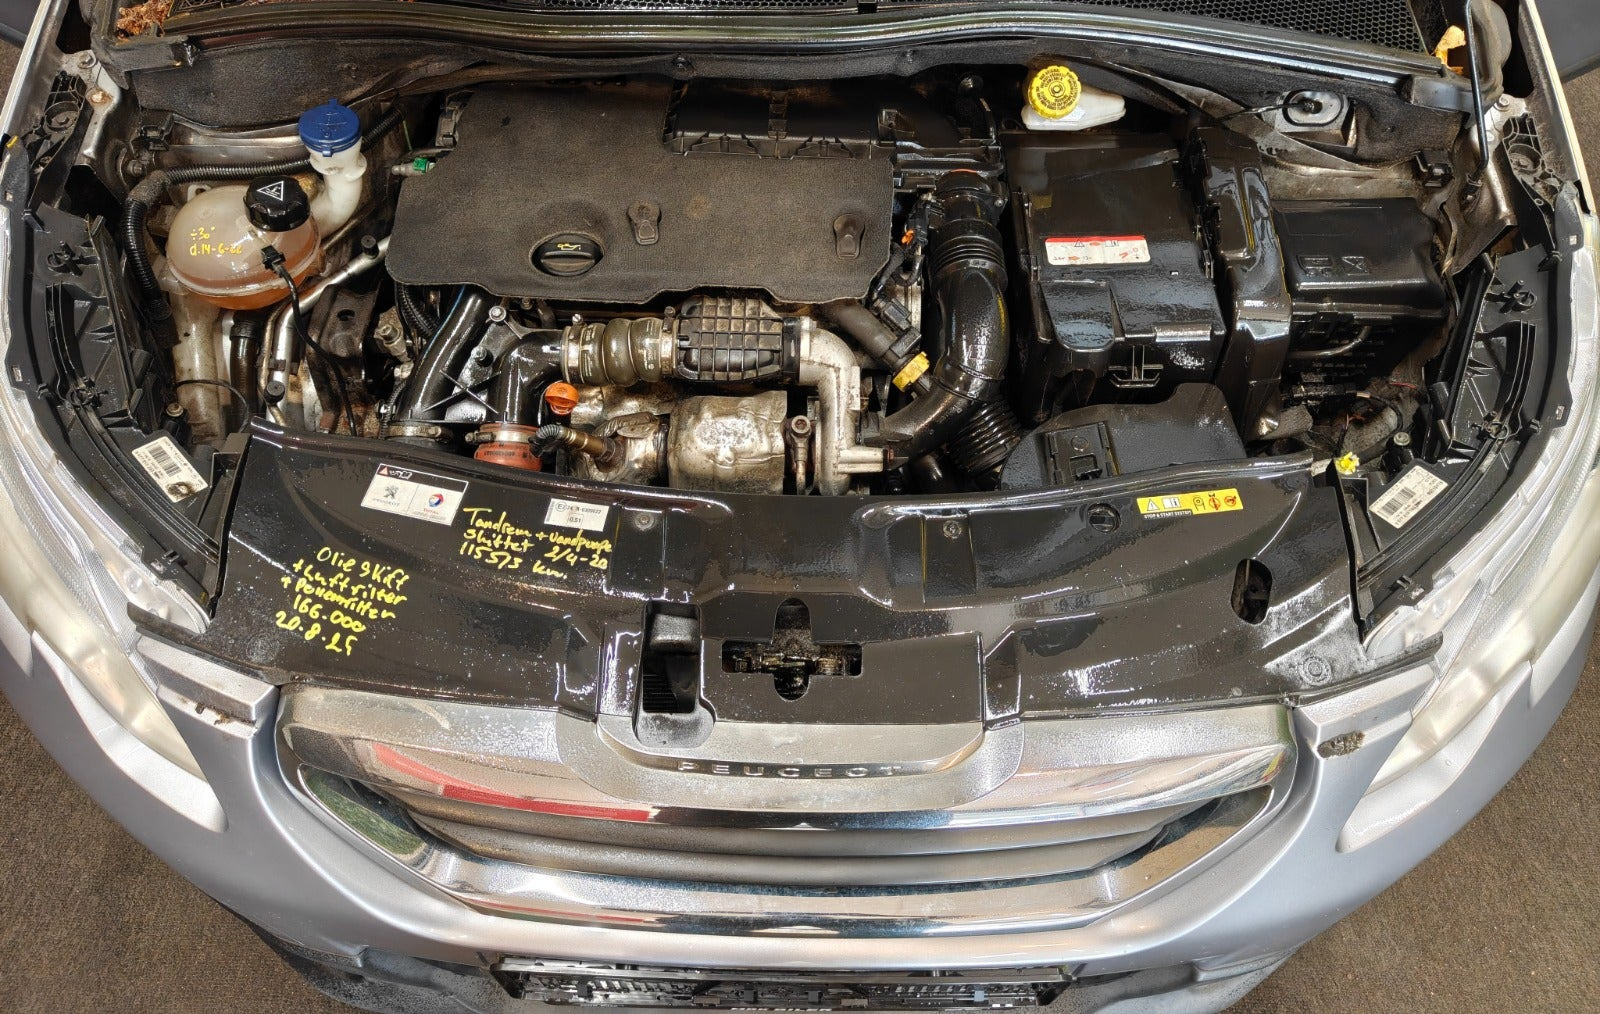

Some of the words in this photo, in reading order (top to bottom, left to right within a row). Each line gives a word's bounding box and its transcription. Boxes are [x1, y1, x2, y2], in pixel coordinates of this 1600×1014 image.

[316, 546, 357, 573] Olie
[293, 593, 367, 633] 166.000
[678, 761, 902, 778] PEUGEOT
